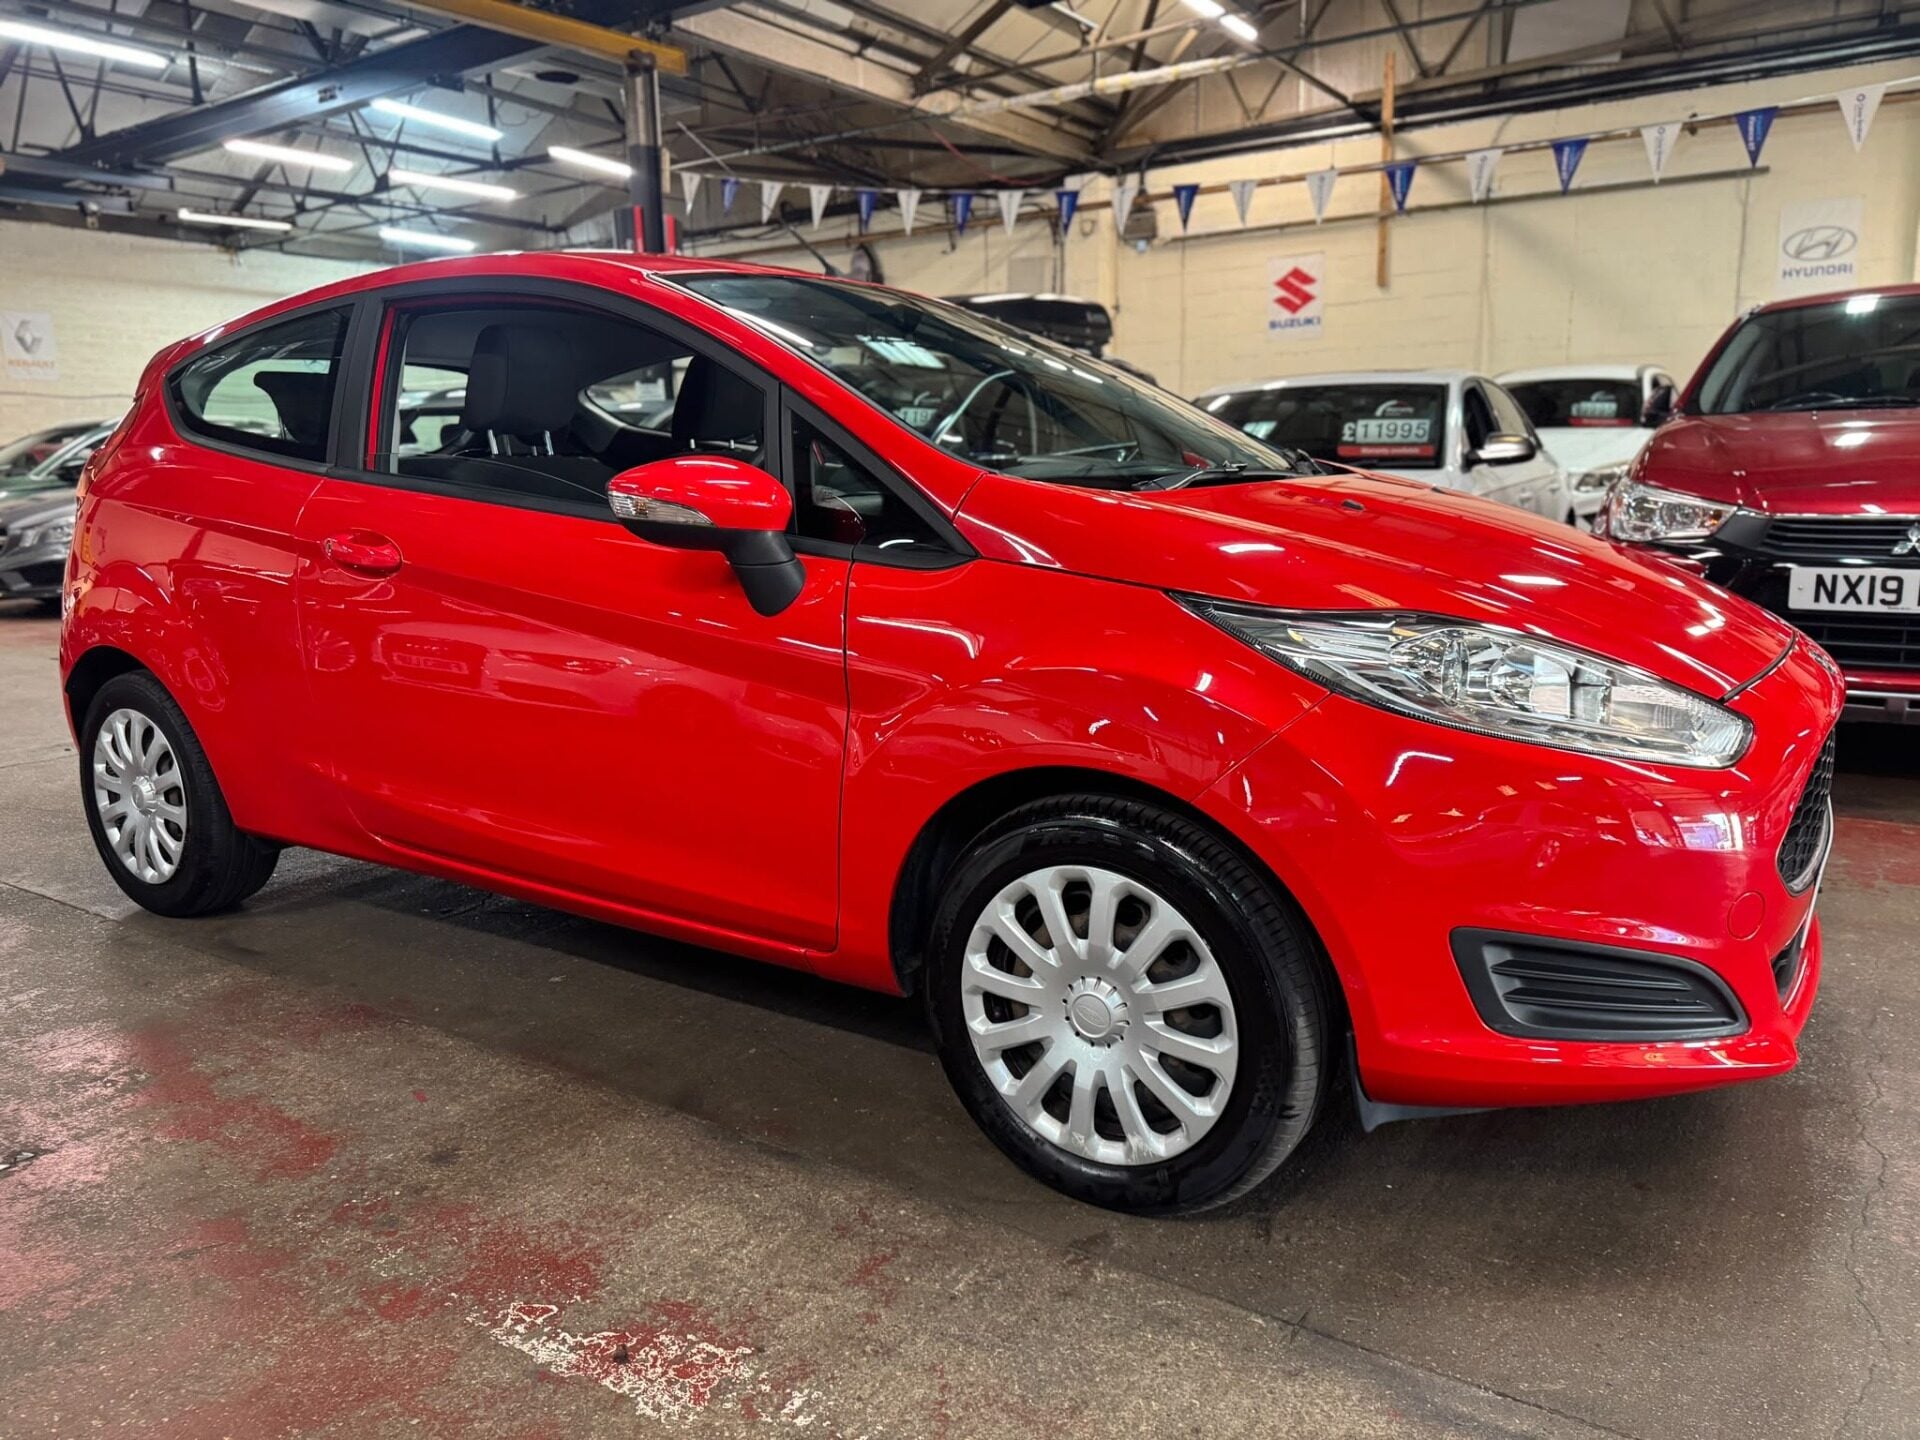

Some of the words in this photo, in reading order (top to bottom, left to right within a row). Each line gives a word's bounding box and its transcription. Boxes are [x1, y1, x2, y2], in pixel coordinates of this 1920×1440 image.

[1782, 263, 1853, 279] HYUNDAI
[1269, 316, 1321, 329] SUZUKI
[1341, 421, 1427, 441] £11995
[1813, 573, 1904, 606] NX19
